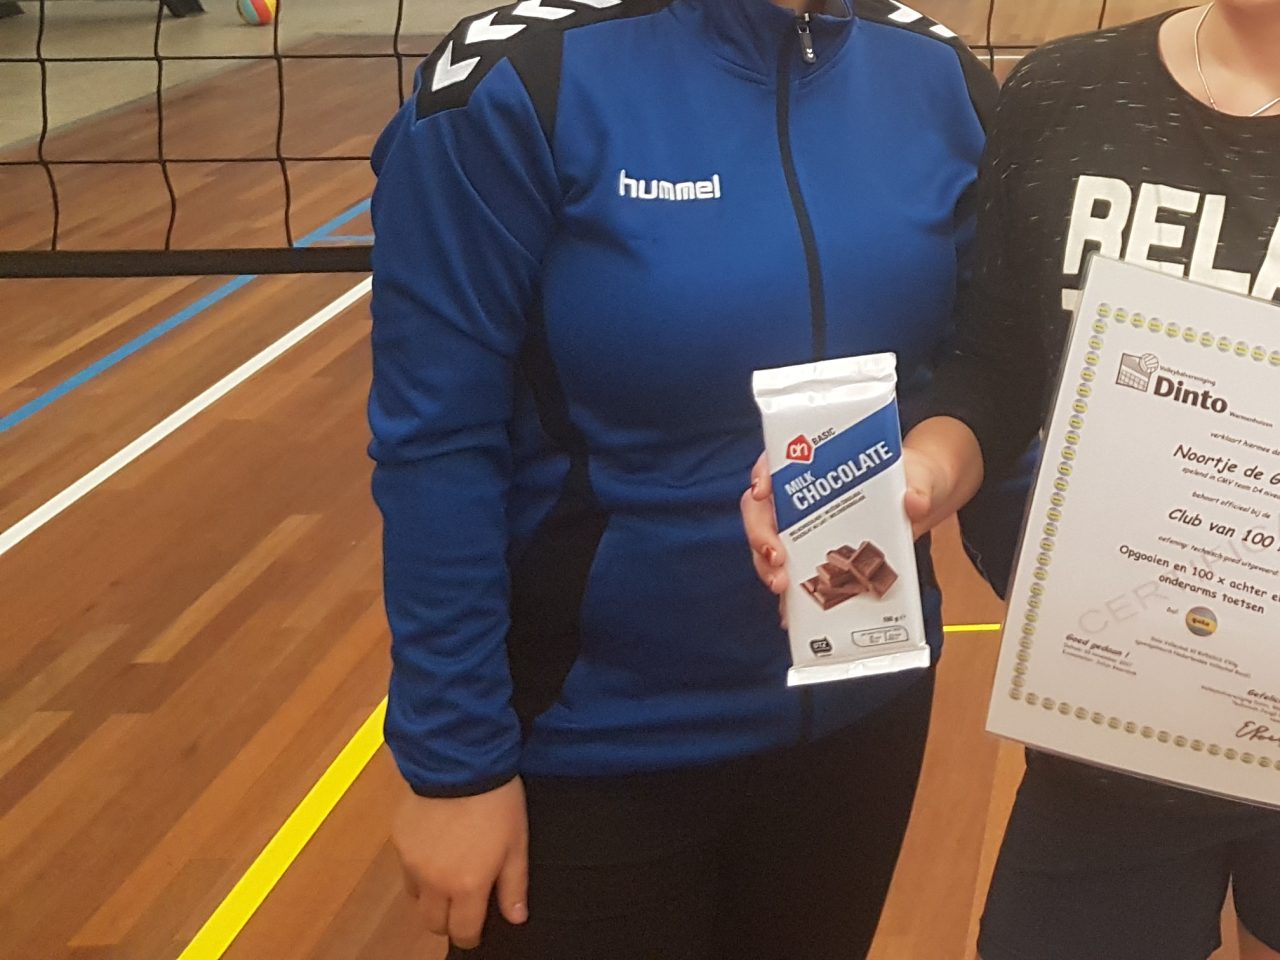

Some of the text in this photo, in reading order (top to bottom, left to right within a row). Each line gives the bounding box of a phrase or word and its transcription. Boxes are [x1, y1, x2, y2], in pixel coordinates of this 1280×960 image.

[619, 169, 721, 201] hummel
[1153, 375, 1228, 414] Dinto
[811, 427, 836, 446] BASIC
[792, 441, 893, 510] CHOCOLATE
[1173, 444, 1238, 474] Noortje
[1243, 465, 1264, 480] de
[784, 470, 816, 495] MILK
[1168, 508, 1202, 527] Club
[1209, 521, 1236, 538] van
[1242, 529, 1275, 548] 100
[1119, 544, 1169, 568] Opgooien
[1173, 561, 1187, 574] en
[1192, 566, 1214, 581] 100
[1217, 576, 1226, 585] x
[1229, 579, 1268, 598] achter
[1158, 574, 1265, 614] onderarms toetsen
